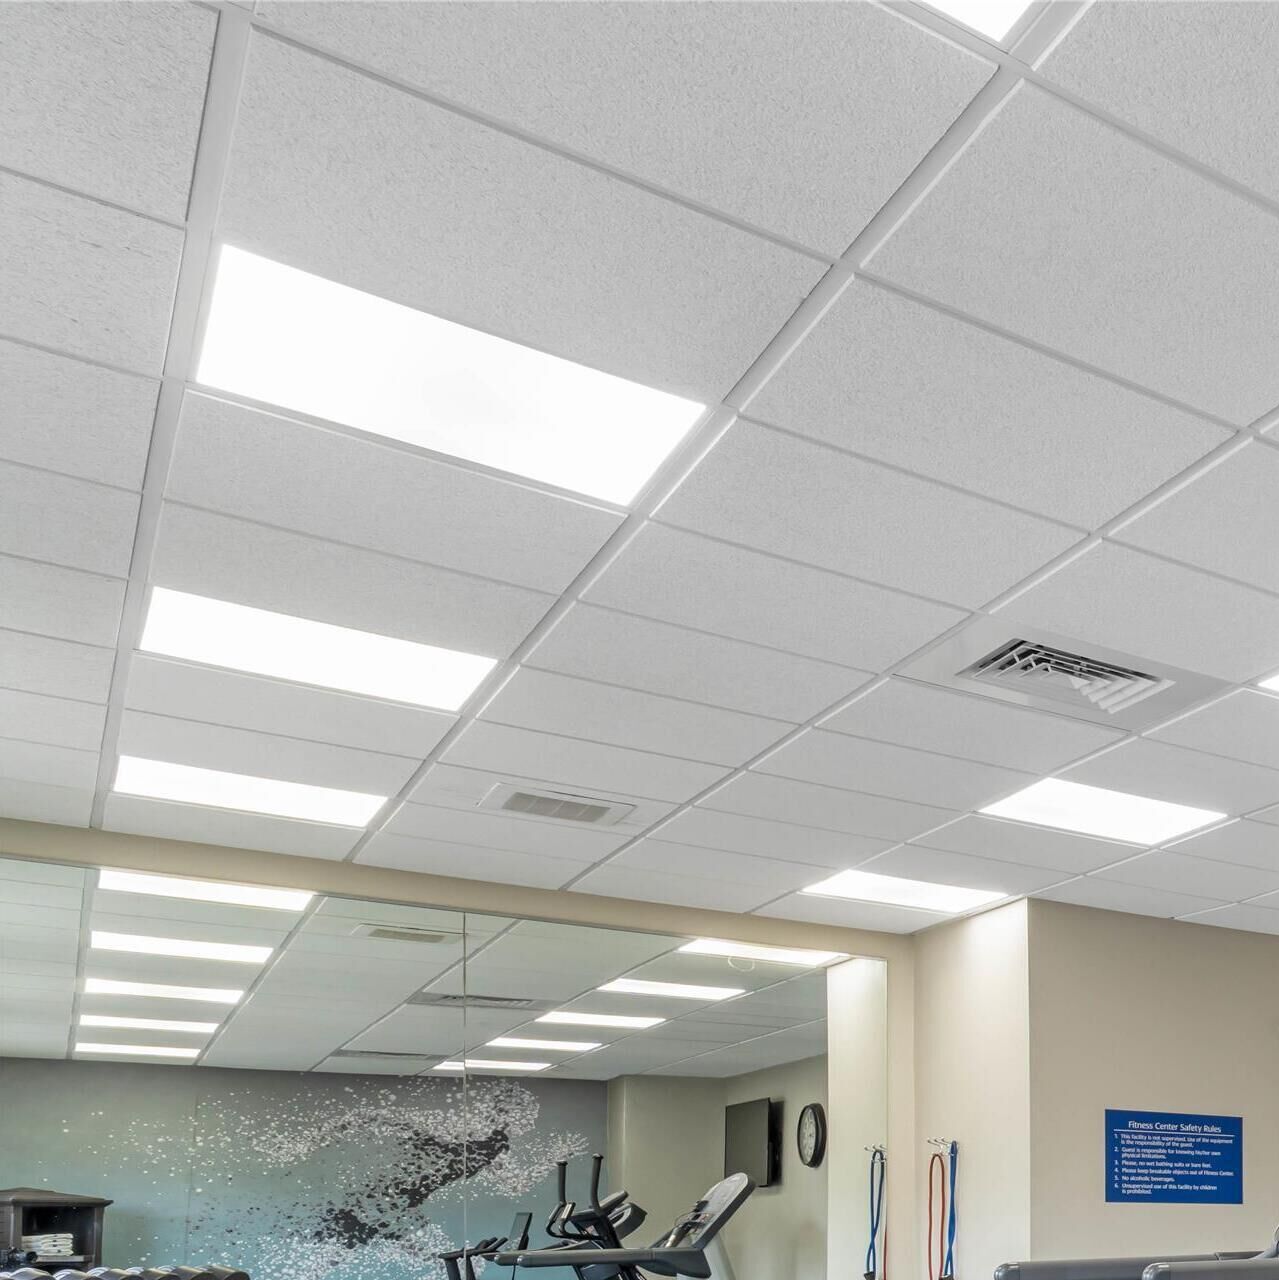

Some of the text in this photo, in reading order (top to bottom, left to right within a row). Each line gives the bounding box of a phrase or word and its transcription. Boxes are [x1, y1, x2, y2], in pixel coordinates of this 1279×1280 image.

[1128, 1120, 1222, 1133] Fitness Center Safety Rules
